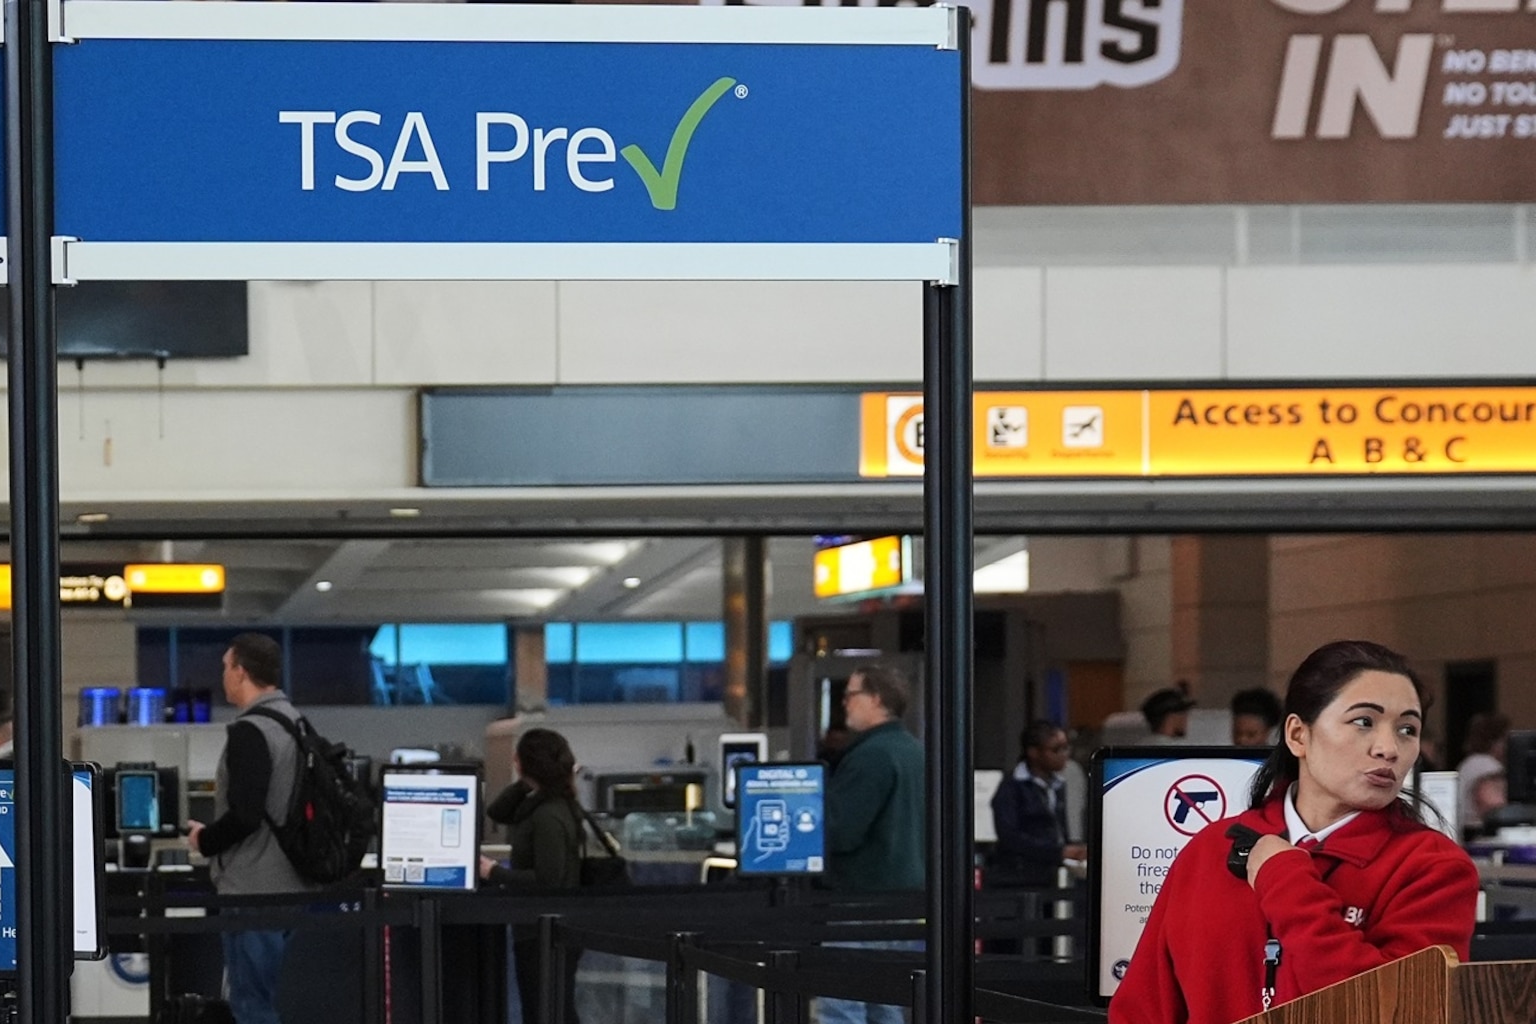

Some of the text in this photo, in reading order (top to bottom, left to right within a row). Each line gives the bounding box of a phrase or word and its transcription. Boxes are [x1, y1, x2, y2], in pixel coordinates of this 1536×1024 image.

[1441, 49, 1486, 73] NO
[1271, 33, 1435, 139] IN
[1442, 81, 1487, 105] NO
[1443, 114, 1536, 139] JUST S
[279, 110, 450, 192] TSA
[477, 112, 616, 192] Pre
[1173, 398, 1302, 425] Access
[1319, 399, 1357, 424] to
[1309, 436, 1467, 463] A B & C
[0, 806, 8, 814] ID
[1131, 846, 1178, 859] Do not
